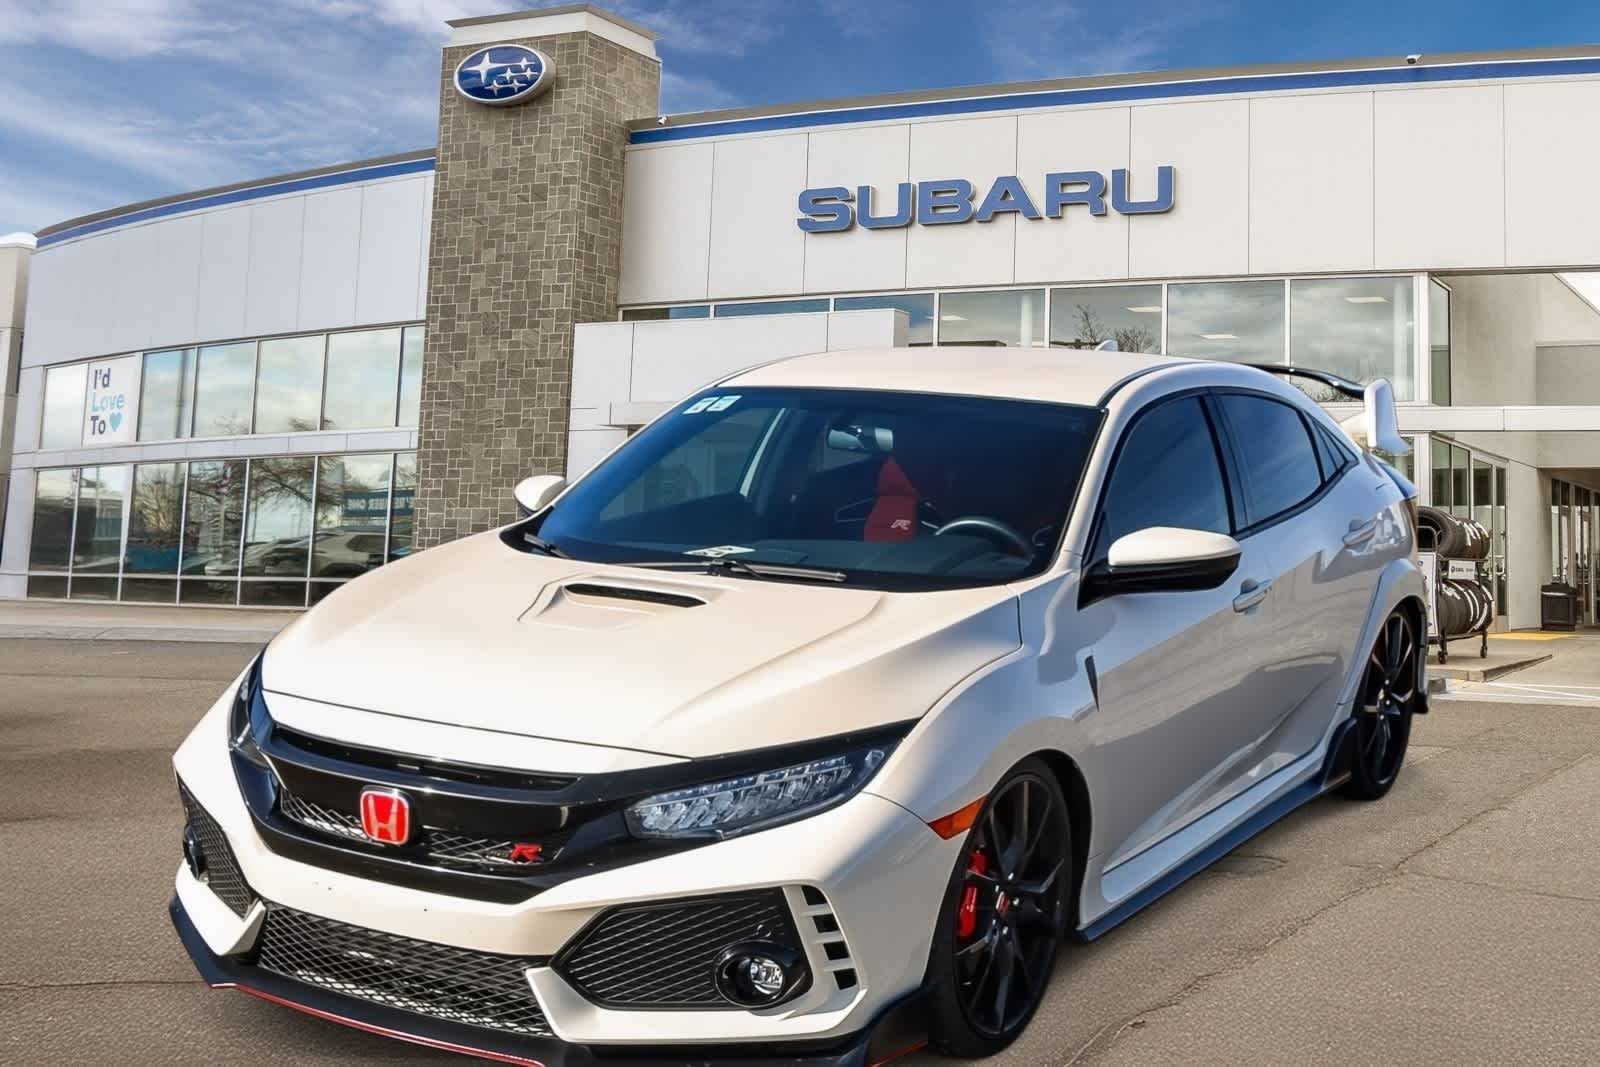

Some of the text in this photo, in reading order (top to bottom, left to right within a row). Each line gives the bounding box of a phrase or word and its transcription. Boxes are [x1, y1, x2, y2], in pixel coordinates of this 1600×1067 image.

[797, 166, 1176, 233] SUBARU
[93, 368, 111, 389] I'd
[91, 392, 125, 412] Love
[90, 416, 106, 435] To
